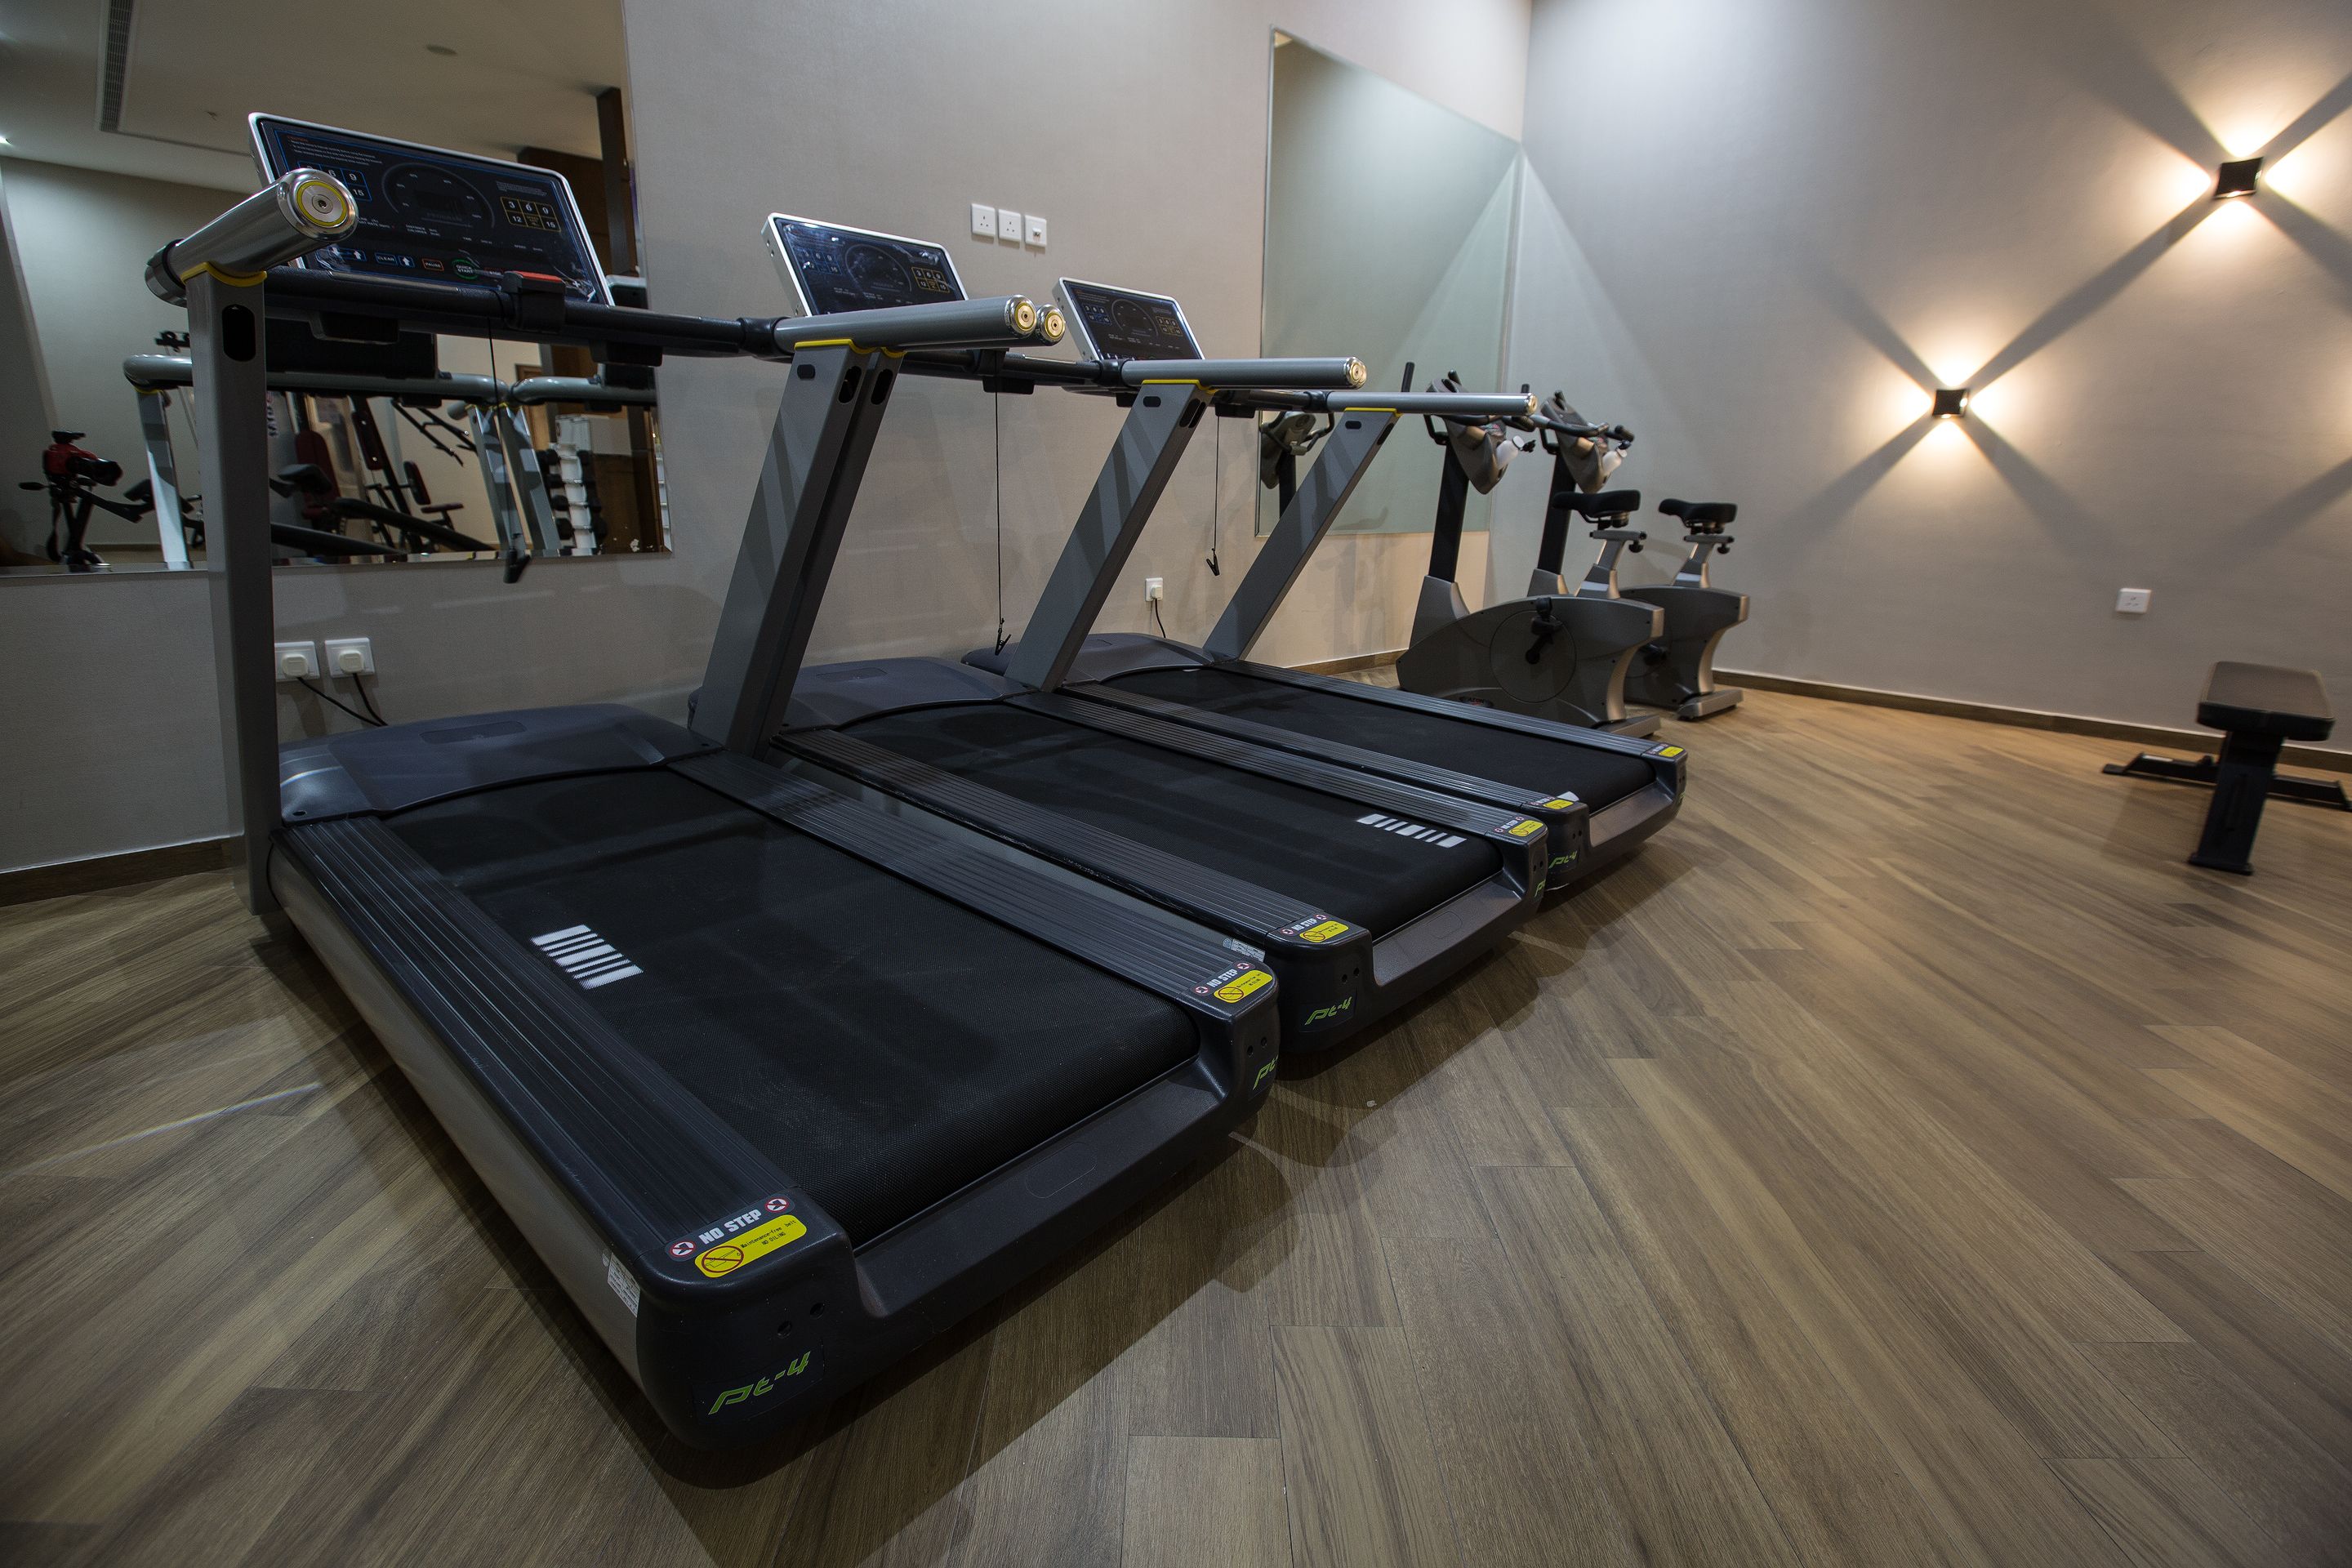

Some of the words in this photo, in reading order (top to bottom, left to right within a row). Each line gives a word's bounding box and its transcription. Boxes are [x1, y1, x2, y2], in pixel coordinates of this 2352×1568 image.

[1206, 978, 1223, 988] NO
[1218, 969, 1238, 982] STEP
[1304, 996, 1353, 1026] Pt-4
[698, 1227, 725, 1245] NO
[724, 1208, 763, 1233] STEP
[740, 1226, 783, 1249] Maintenance-free
[785, 1219, 797, 1228] belt
[761, 1238, 770, 1247] NO
[769, 1232, 786, 1244] OILING
[708, 1350, 812, 1415] Pt-4
